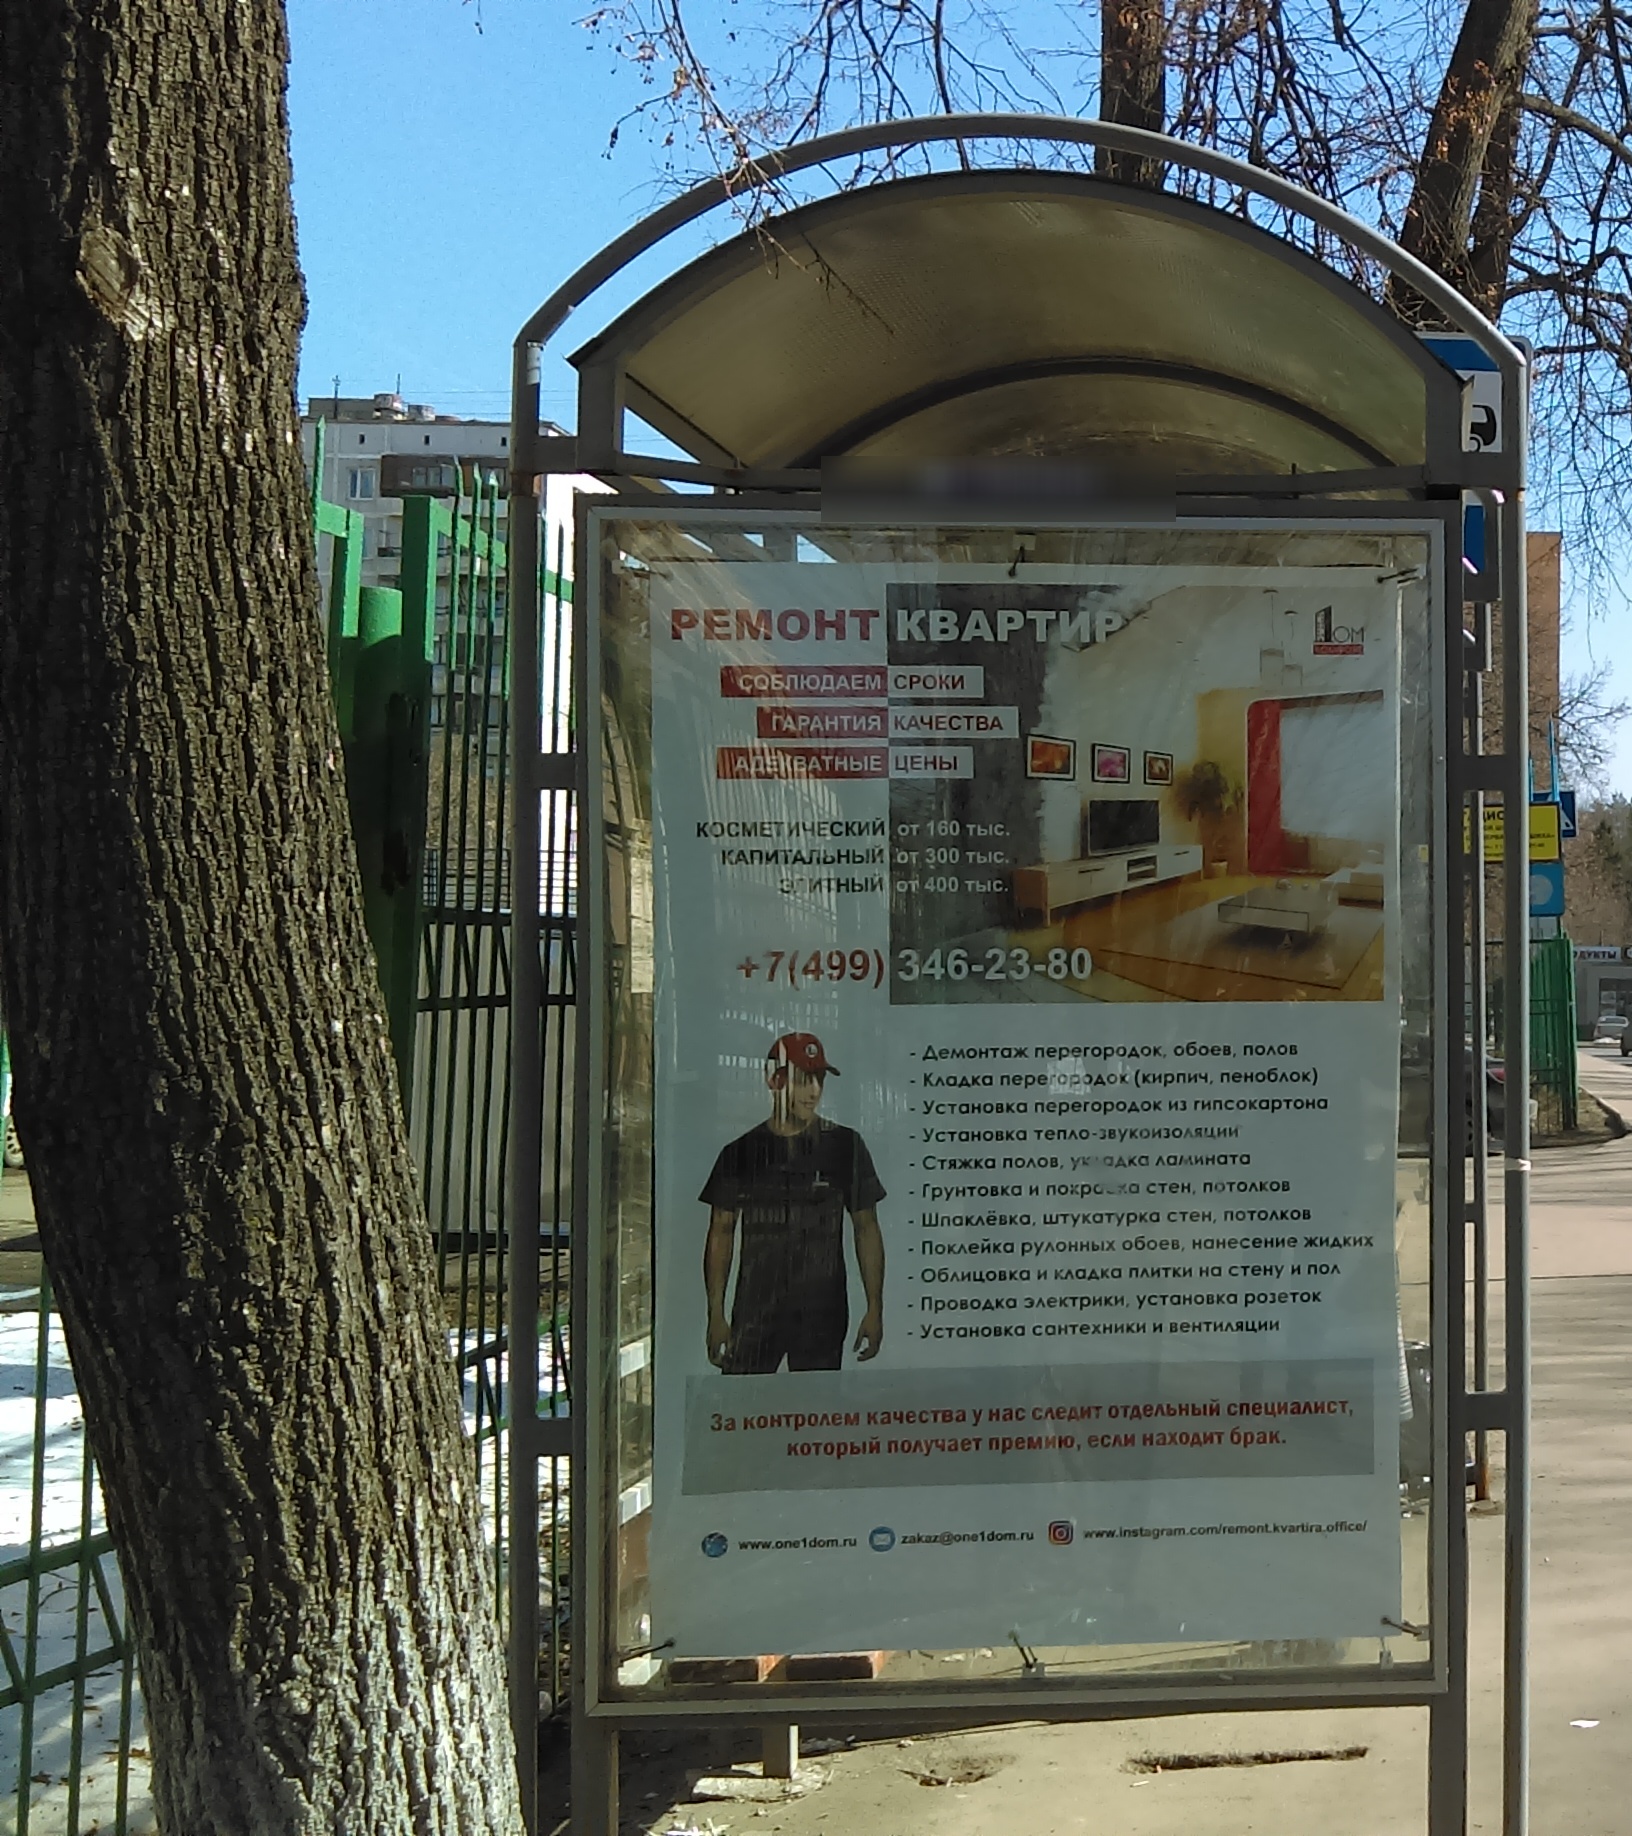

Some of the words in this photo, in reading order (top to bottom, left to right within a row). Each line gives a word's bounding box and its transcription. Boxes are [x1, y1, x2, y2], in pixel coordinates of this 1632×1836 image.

[671, 608, 880, 641] РЕМОНТ
[897, 609, 1124, 643] КВАРТИР
[739, 674, 882, 693] СОБЛЮДАЕМ
[894, 674, 965, 691] СРОКИ
[772, 715, 882, 732] ГАРАНТИЯ
[894, 715, 1005, 732] КАЧЕСТВА
[734, 755, 882, 774] АДЕКВАТНЫЕ
[895, 755, 958, 773] ЦЕНЫ
[696, 817, 886, 838] КОСМЕТИЧЕСКИЙ
[897, 824, 920, 837] от
[926, 820, 961, 837] 160
[966, 824, 1010, 837] тыс.
[722, 845, 885, 866] КАПИТАЛЬНЫЙ
[896, 851, 919, 864] от
[925, 848, 960, 864] 300
[965, 851, 1010, 864] тыс.
[896, 880, 919, 893] от
[924, 876, 959, 893] 400
[964, 880, 1009, 893] тыс.
[737, 949, 885, 991] +7(499)
[898, 948, 1092, 981] 346-23-80
[922, 1044, 1029, 1062] Демонтаж
[1034, 1044, 1167, 1061] перегородок,
[1173, 1041, 1237, 1058] обоев,
[1243, 1044, 1299, 1057] полов
[923, 1071, 993, 1087] Кладка
[1000, 1071, 1129, 1090] перегородок
[1134, 1068, 1214, 1089] (кирпич,
[1220, 1067, 1319, 1086] пеноблок)
[922, 1099, 1028, 1116] Установка
[1034, 1099, 1162, 1116] перегородок
[1168, 1100, 1188, 1112] из
[1193, 1098, 1329, 1114] гипсокартона
[922, 1127, 1028, 1143] Установка
[1033, 1125, 1239, 1143] тепло-звукоизоляции
[922, 1155, 997, 1171] Стяжка
[1002, 1155, 1064, 1171] полов,
[1070, 1154, 1150, 1171] укадка
[1155, 1153, 1251, 1167] ламината
[922, 1183, 1023, 1202] Грунтовка
[1029, 1184, 1040, 1196] и
[1146, 1181, 1197, 1196] стен,
[1203, 1180, 1291, 1194] потолков
[921, 1209, 1036, 1228] Шпаклёвка,
[1042, 1210, 1161, 1227] штукатурка
[1167, 1209, 1217, 1224] стен,
[1224, 1208, 1312, 1222] потолков
[921, 1238, 1015, 1256] Поклейка
[1020, 1239, 1117, 1257] рулонных
[1122, 1235, 1186, 1252] обоев,
[1192, 1236, 1298, 1250] нанесение
[1304, 1234, 1374, 1249] жидких
[921, 1267, 1031, 1284] Облицовка
[1037, 1269, 1048, 1281] и
[1054, 1266, 1123, 1282] кладка
[1129, 1265, 1193, 1279] плитки
[1199, 1265, 1223, 1279] на
[1228, 1263, 1285, 1280] стену
[1291, 1264, 1302, 1276] и
[1307, 1262, 1341, 1276] пол
[921, 1296, 1017, 1314] Проводка
[1024, 1294, 1130, 1311] электрики,
[1136, 1292, 1239, 1310] установка
[1244, 1290, 1323, 1308] розеток
[920, 1323, 1026, 1340] Установка
[1032, 1321, 1147, 1337] сантехники
[1153, 1321, 1163, 1334] и
[1169, 1319, 1280, 1334] вентиляции
[710, 1413, 737, 1432] За
[743, 1410, 860, 1431] контролем
[867, 1407, 967, 1426] качества
[972, 1408, 983, 1427] у
[988, 1407, 1027, 1422] нас
[1032, 1404, 1102, 1423] следит
[1108, 1399, 1221, 1420] отдельный
[1227, 1401, 1354, 1419] специалист,
[787, 1436, 881, 1460] который
[887, 1437, 983, 1457] получает
[989, 1435, 1081, 1454] премию,
[1088, 1433, 1136, 1448] если
[1142, 1431, 1225, 1449] находит
[1230, 1426, 1287, 1449] брак.
[738, 1537, 857, 1550] www.one1dom.ru
[901, 1530, 1034, 1546] zakaz@one1dom.ru
